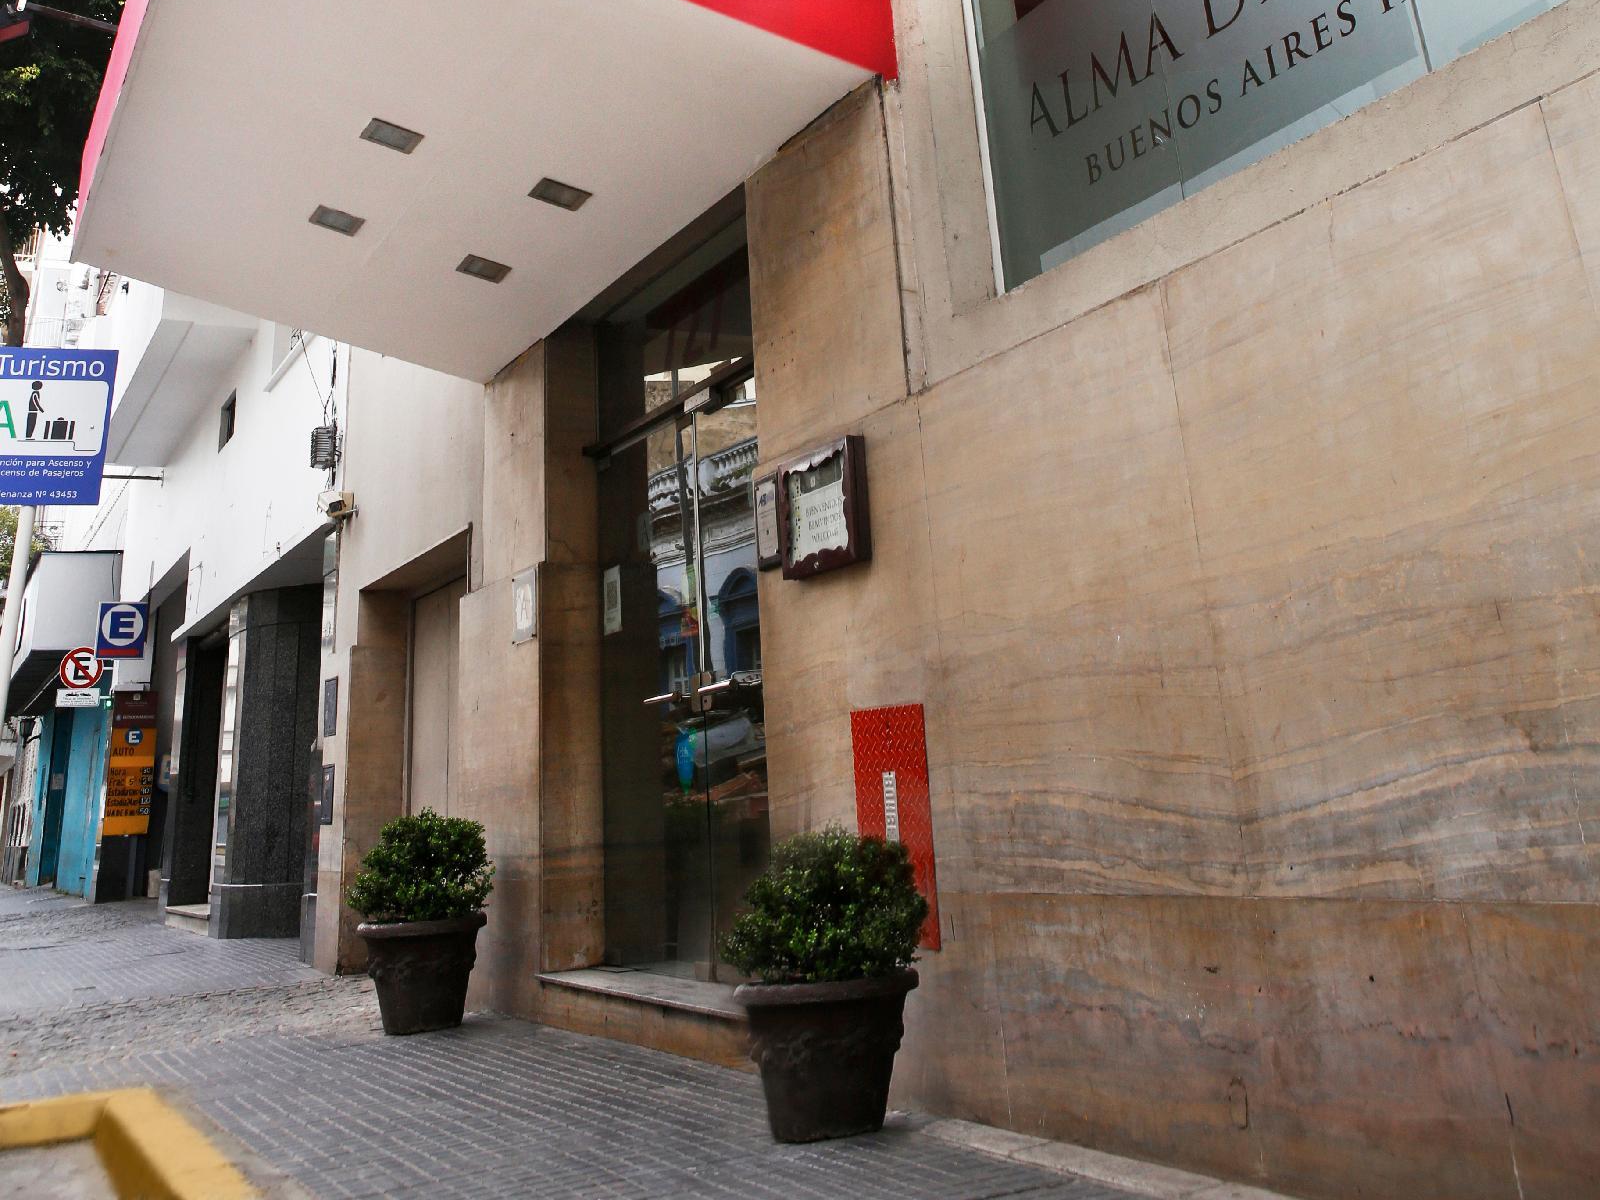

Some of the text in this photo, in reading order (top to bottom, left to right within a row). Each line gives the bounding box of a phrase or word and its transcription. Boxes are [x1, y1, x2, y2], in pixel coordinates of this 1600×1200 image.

[1029, 11, 1184, 144] ALMA
[1087, 79, 1223, 186] BUENOS
[0, 354, 105, 377] Turismo
[25, 460, 46, 469] para
[48, 459, 83, 467] Ascenso
[28, 468, 40, 477] de
[42, 469, 84, 478] Pasajeros
[0, 490, 33, 498] enanza
[49, 490, 78, 498] 43453
[109, 611, 137, 639] E
[73, 656, 92, 681] E
[128, 730, 141, 744] E
[112, 747, 135, 757] AUTO
